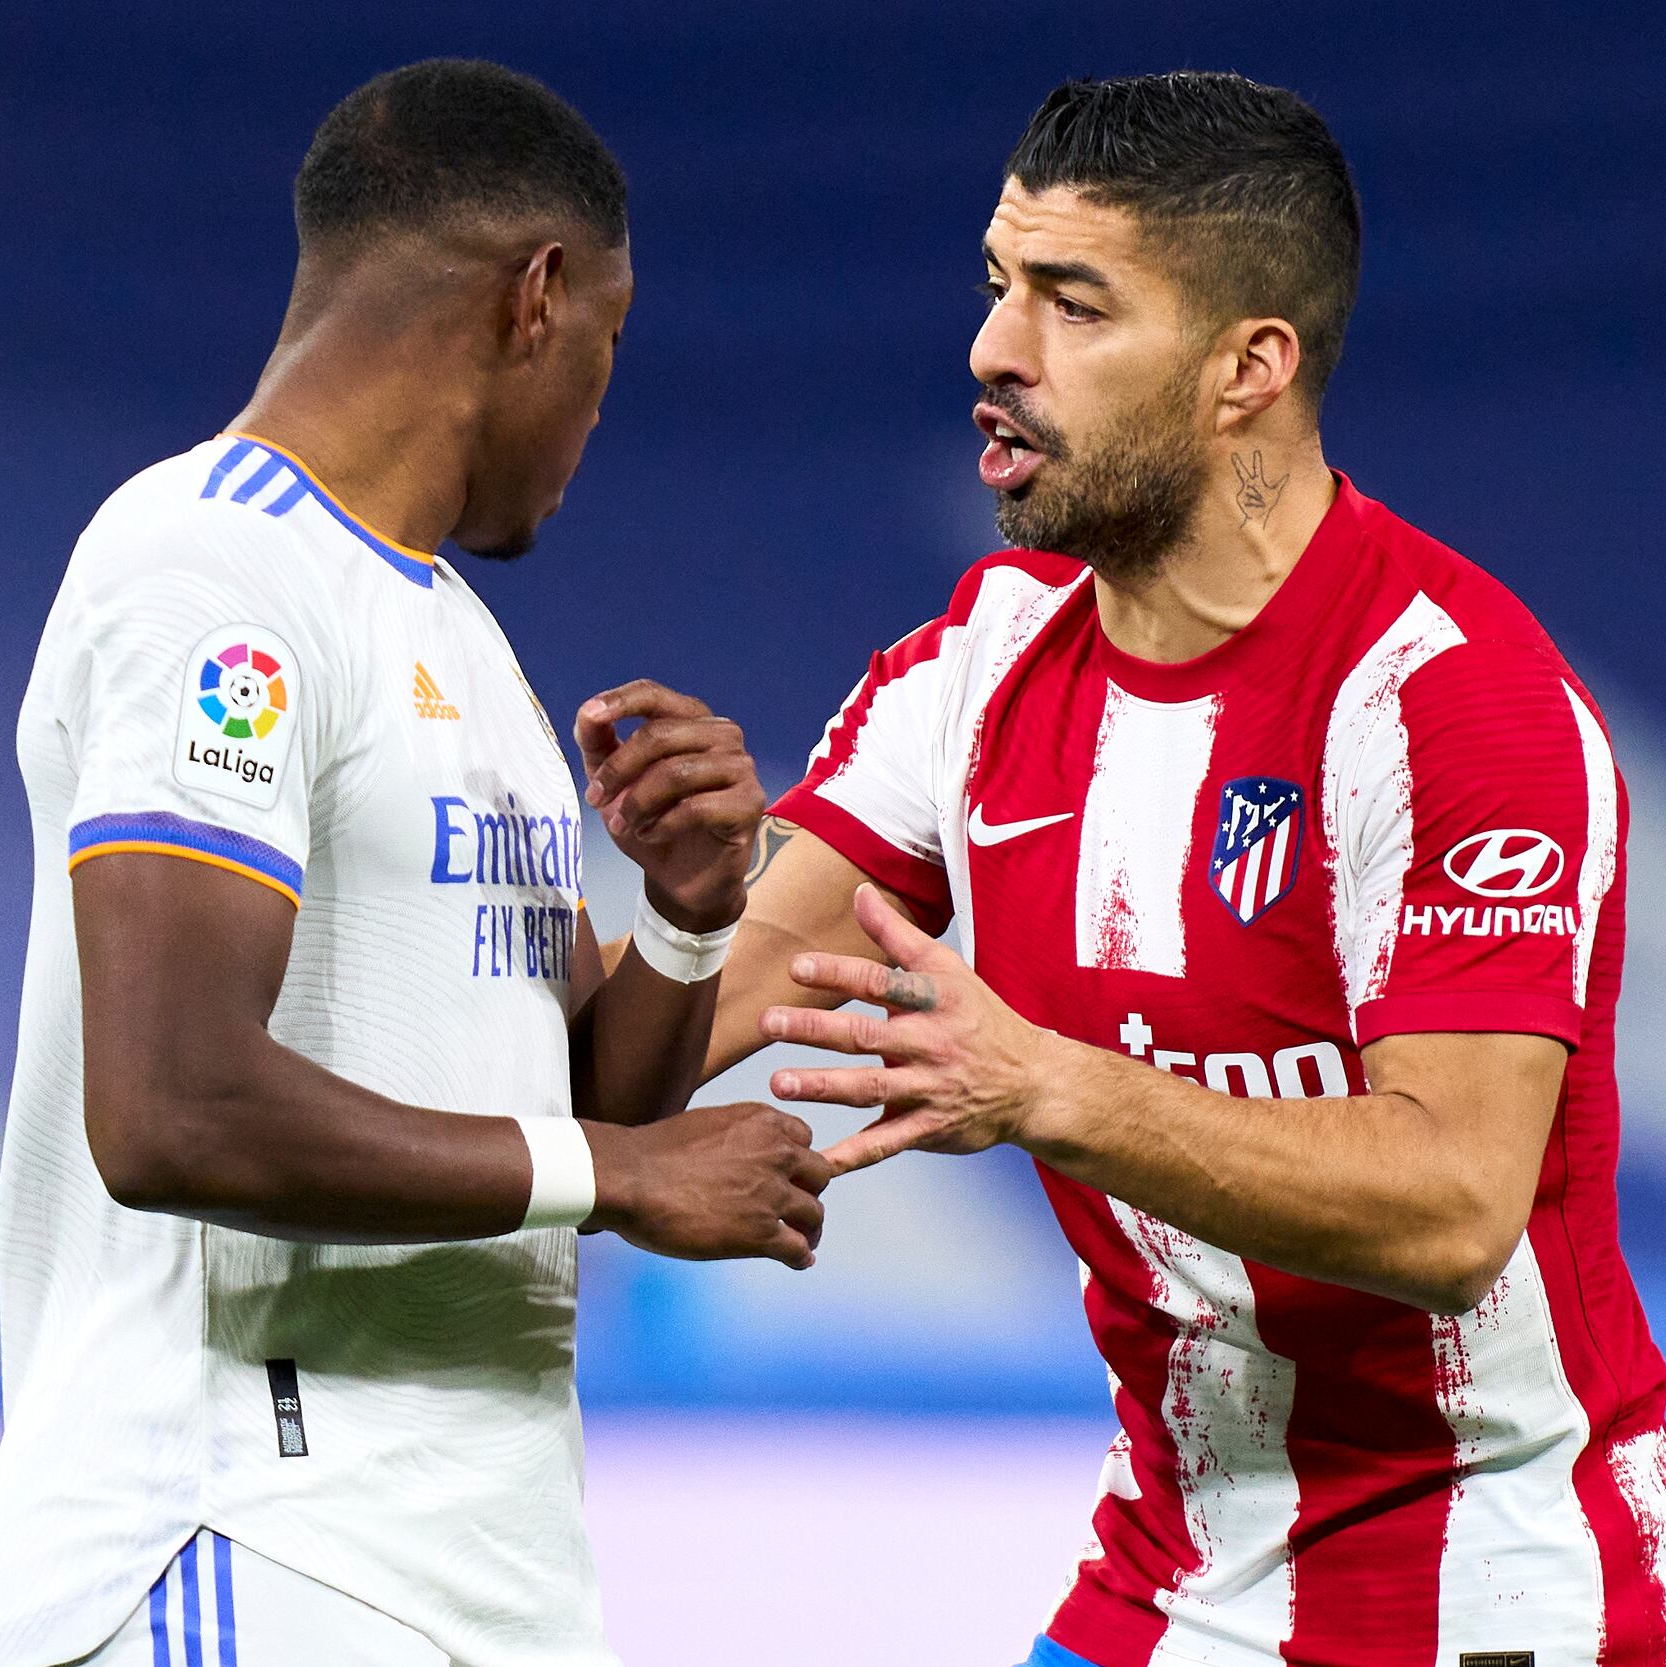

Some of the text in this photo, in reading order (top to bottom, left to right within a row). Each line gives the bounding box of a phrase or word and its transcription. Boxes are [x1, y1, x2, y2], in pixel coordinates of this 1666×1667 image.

[188, 740, 274, 784] LaLiga
[472, 904, 513, 977] FLY
[1402, 904, 1577, 936] HYUNDAI
